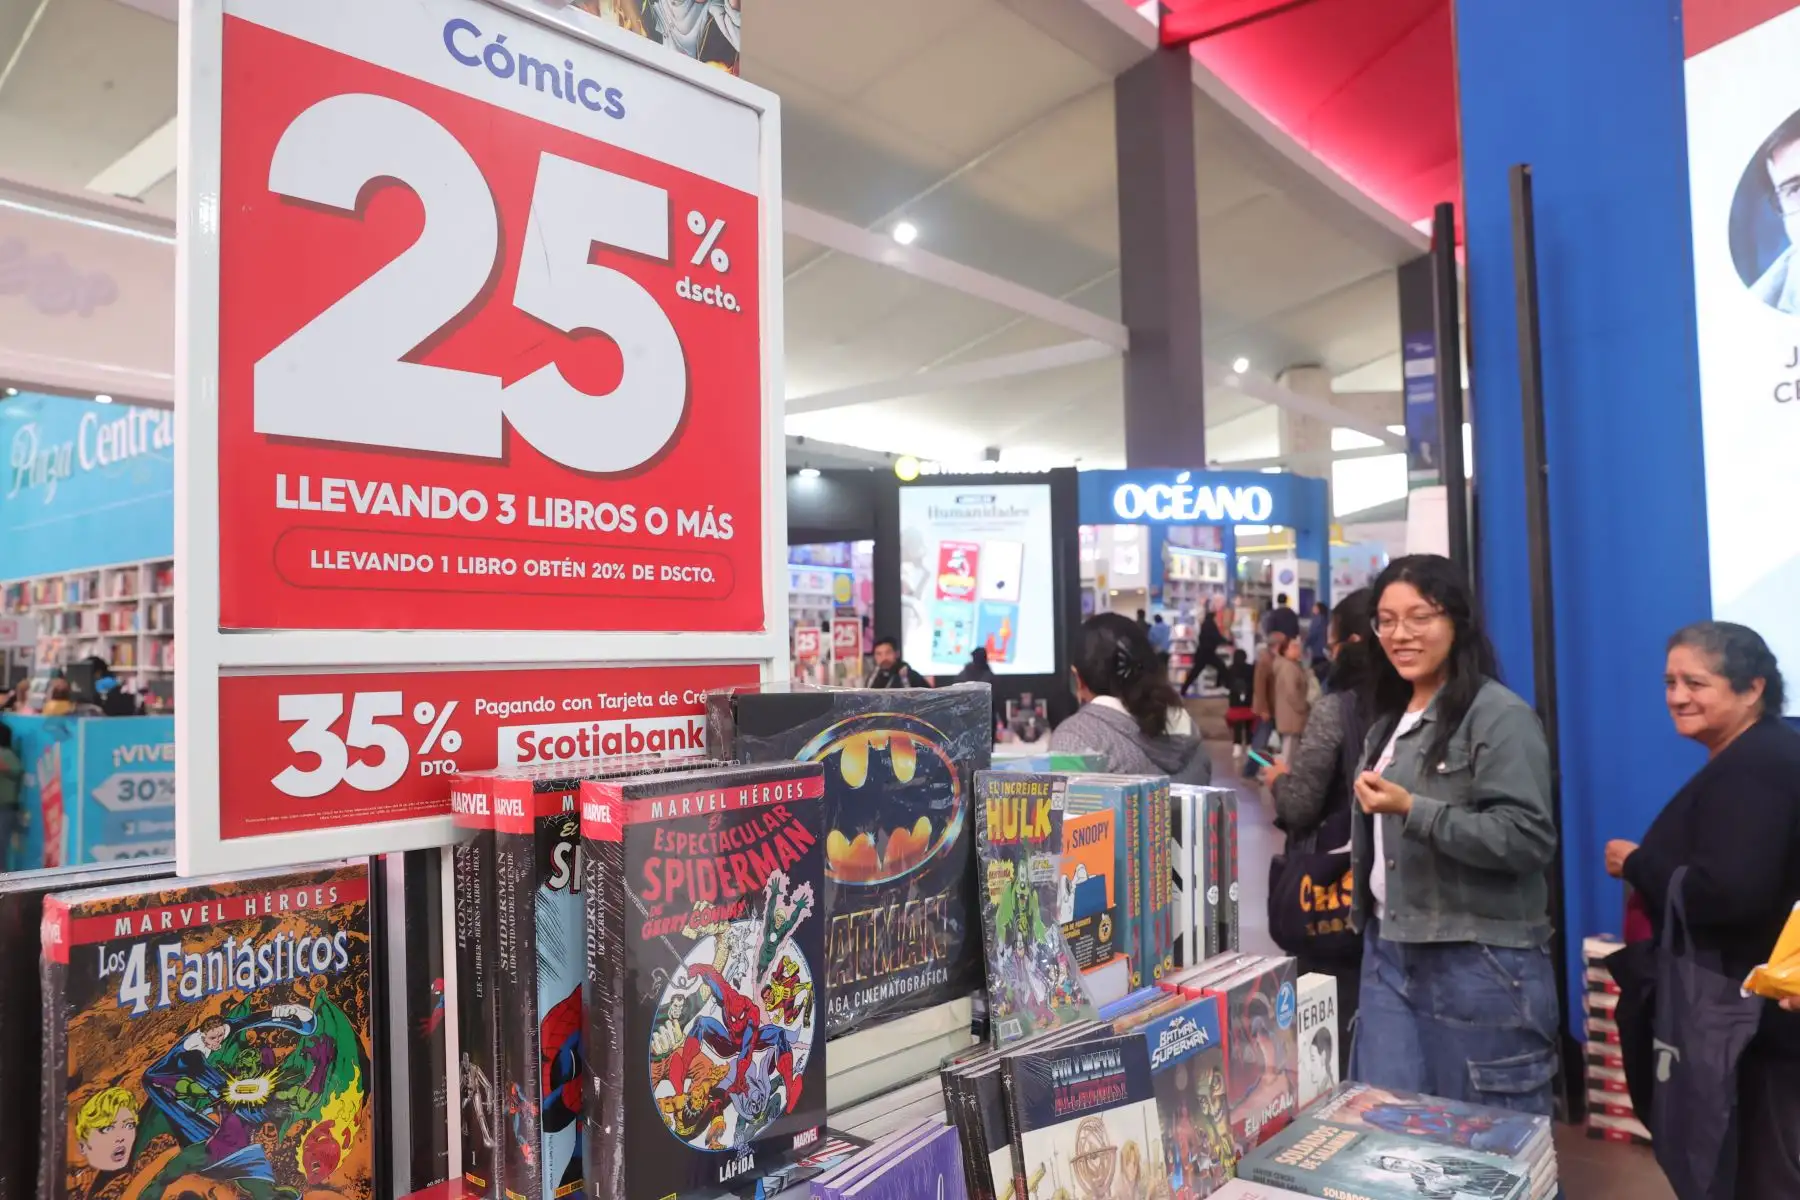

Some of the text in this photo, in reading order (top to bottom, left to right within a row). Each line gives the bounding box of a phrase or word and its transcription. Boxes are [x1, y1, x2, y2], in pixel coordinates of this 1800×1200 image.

[443, 18, 626, 120] Cómics
[676, 276, 741, 313] dscto.
[77, 405, 175, 471] Centra
[276, 473, 734, 540] LLEVANDO 3 LIBROS O MÁS
[1112, 471, 1273, 522] OCÉANO
[311, 549, 716, 583] LLEVANDO 1 LIBRO OBTÉN 20% DE DSCTO.
[798, 633, 817, 651] 25
[835, 624, 856, 647] 25
[475, 696, 556, 718] Pagando
[562, 697, 593, 711] con
[598, 693, 653, 712] Tarjeta
[659, 690, 678, 706] de
[516, 719, 704, 764] Scotiabank
[420, 759, 459, 776] DTO.
[651, 782, 804, 819] MARVEL HÉROES
[988, 781, 999, 795] EL
[582, 802, 612, 824] MARVEL
[654, 804, 793, 855] ESPECTACULAR
[986, 798, 1053, 842] HULK
[1132, 793, 1140, 854] MARVEL
[1153, 790, 1162, 849] MARVEL
[1072, 820, 1109, 849] SNOOPY
[507, 851, 515, 892] DUENDE
[642, 818, 817, 904] SPIDERMAN
[455, 845, 467, 949] IRON MAN
[473, 877, 481, 904] KIRBY
[1133, 859, 1141, 917] COMICS
[115, 886, 338, 937] MARVEL HÉROES
[466, 907, 474, 937] NACE
[497, 851, 509, 971] SPIDERMAN
[586, 859, 597, 982] SPIDERMAN
[597, 907, 605, 940] GERRY
[475, 943, 483, 975] LIEBER
[508, 914, 517, 969] IDENTIDAD
[597, 942, 605, 955] DE
[826, 894, 947, 988] ATMAN
[118, 942, 151, 1018] 4
[157, 929, 350, 1009] Fantásticos
[509, 970, 518, 984] LA
[827, 967, 949, 1015] AGA CINEMATOGRÁFICA
[1280, 986, 1290, 1013] 2
[1298, 996, 1335, 1034] IERBA
[1151, 1027, 1209, 1070] SUPERMAN
[1159, 1021, 1198, 1049] BATMAN
[793, 1127, 819, 1150] MARVEL
[719, 1155, 755, 1184] LÁPIDA
